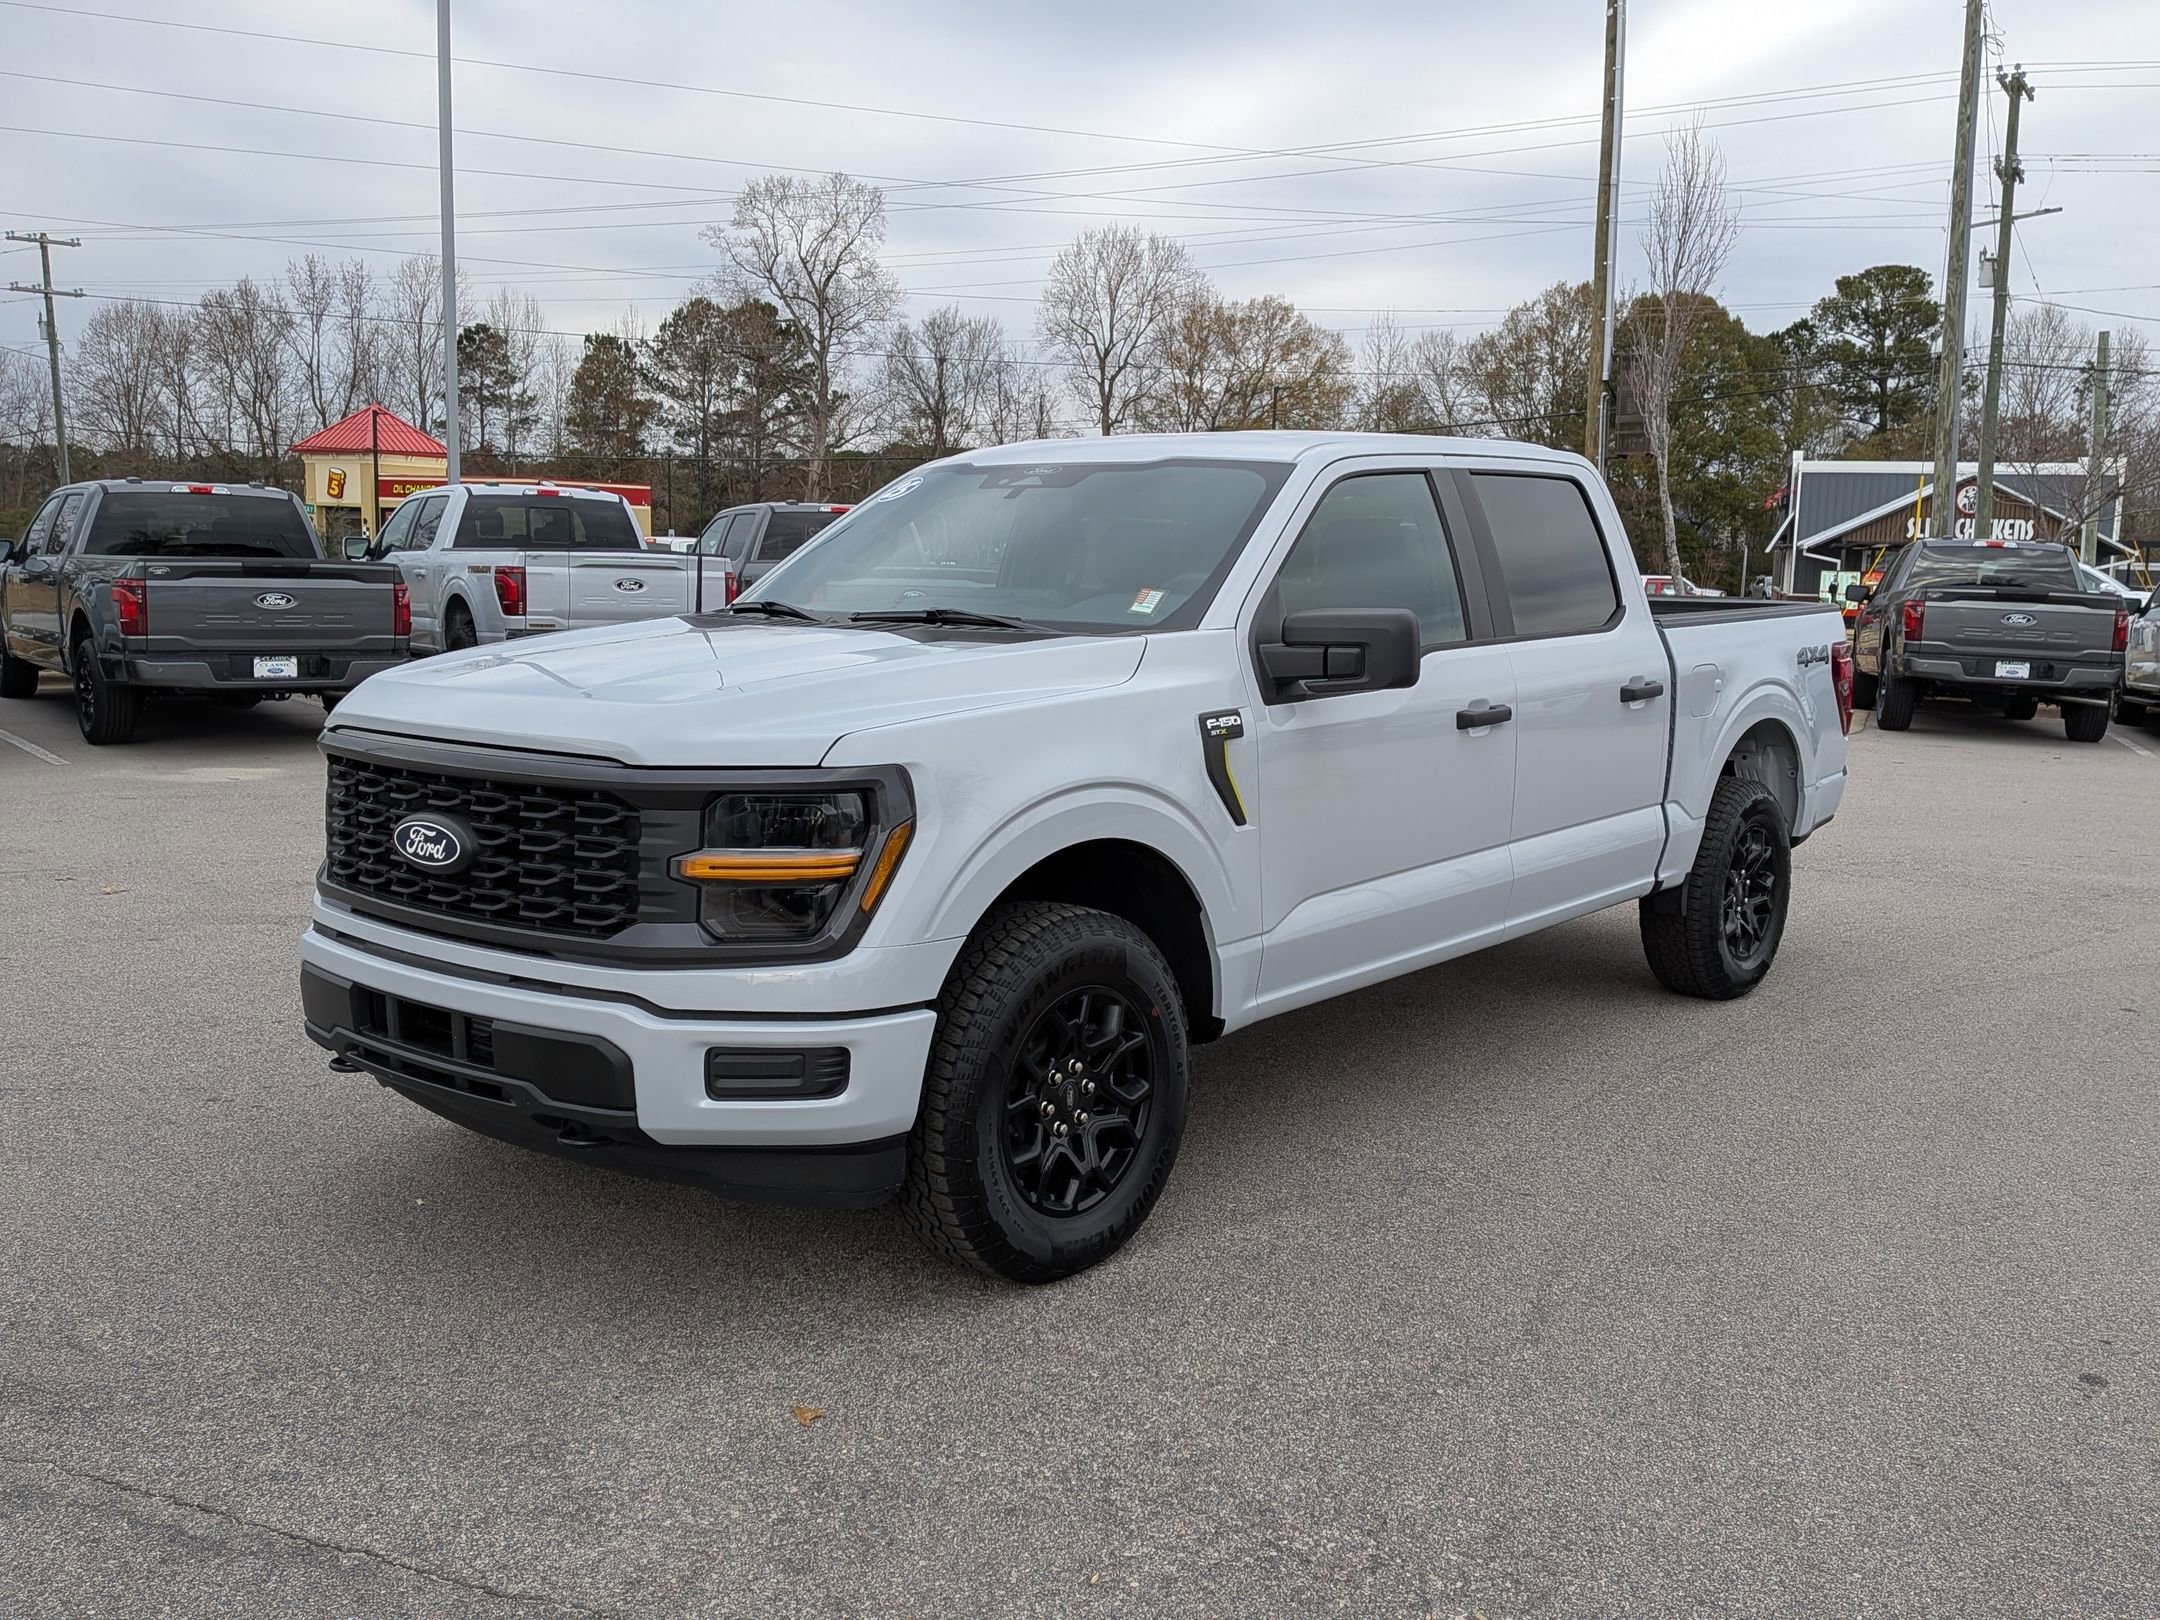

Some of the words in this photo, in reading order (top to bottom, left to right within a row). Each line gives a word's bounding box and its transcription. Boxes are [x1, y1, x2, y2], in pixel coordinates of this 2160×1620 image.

[329, 480, 339, 495] 5
[392, 484, 404, 494] OIL
[1906, 517, 1932, 539] SLI
[1954, 518, 2035, 541] CHKENS
[621, 580, 640, 591] Ford
[263, 594, 288, 606] Ford
[2009, 615, 2028, 625] Ford
[1206, 715, 1241, 730] F-150
[1210, 728, 1228, 737] STX
[405, 826, 447, 860] Ford
[1152, 982, 1183, 1050] TERRITORY
[1176, 1061, 1184, 1078] AT
